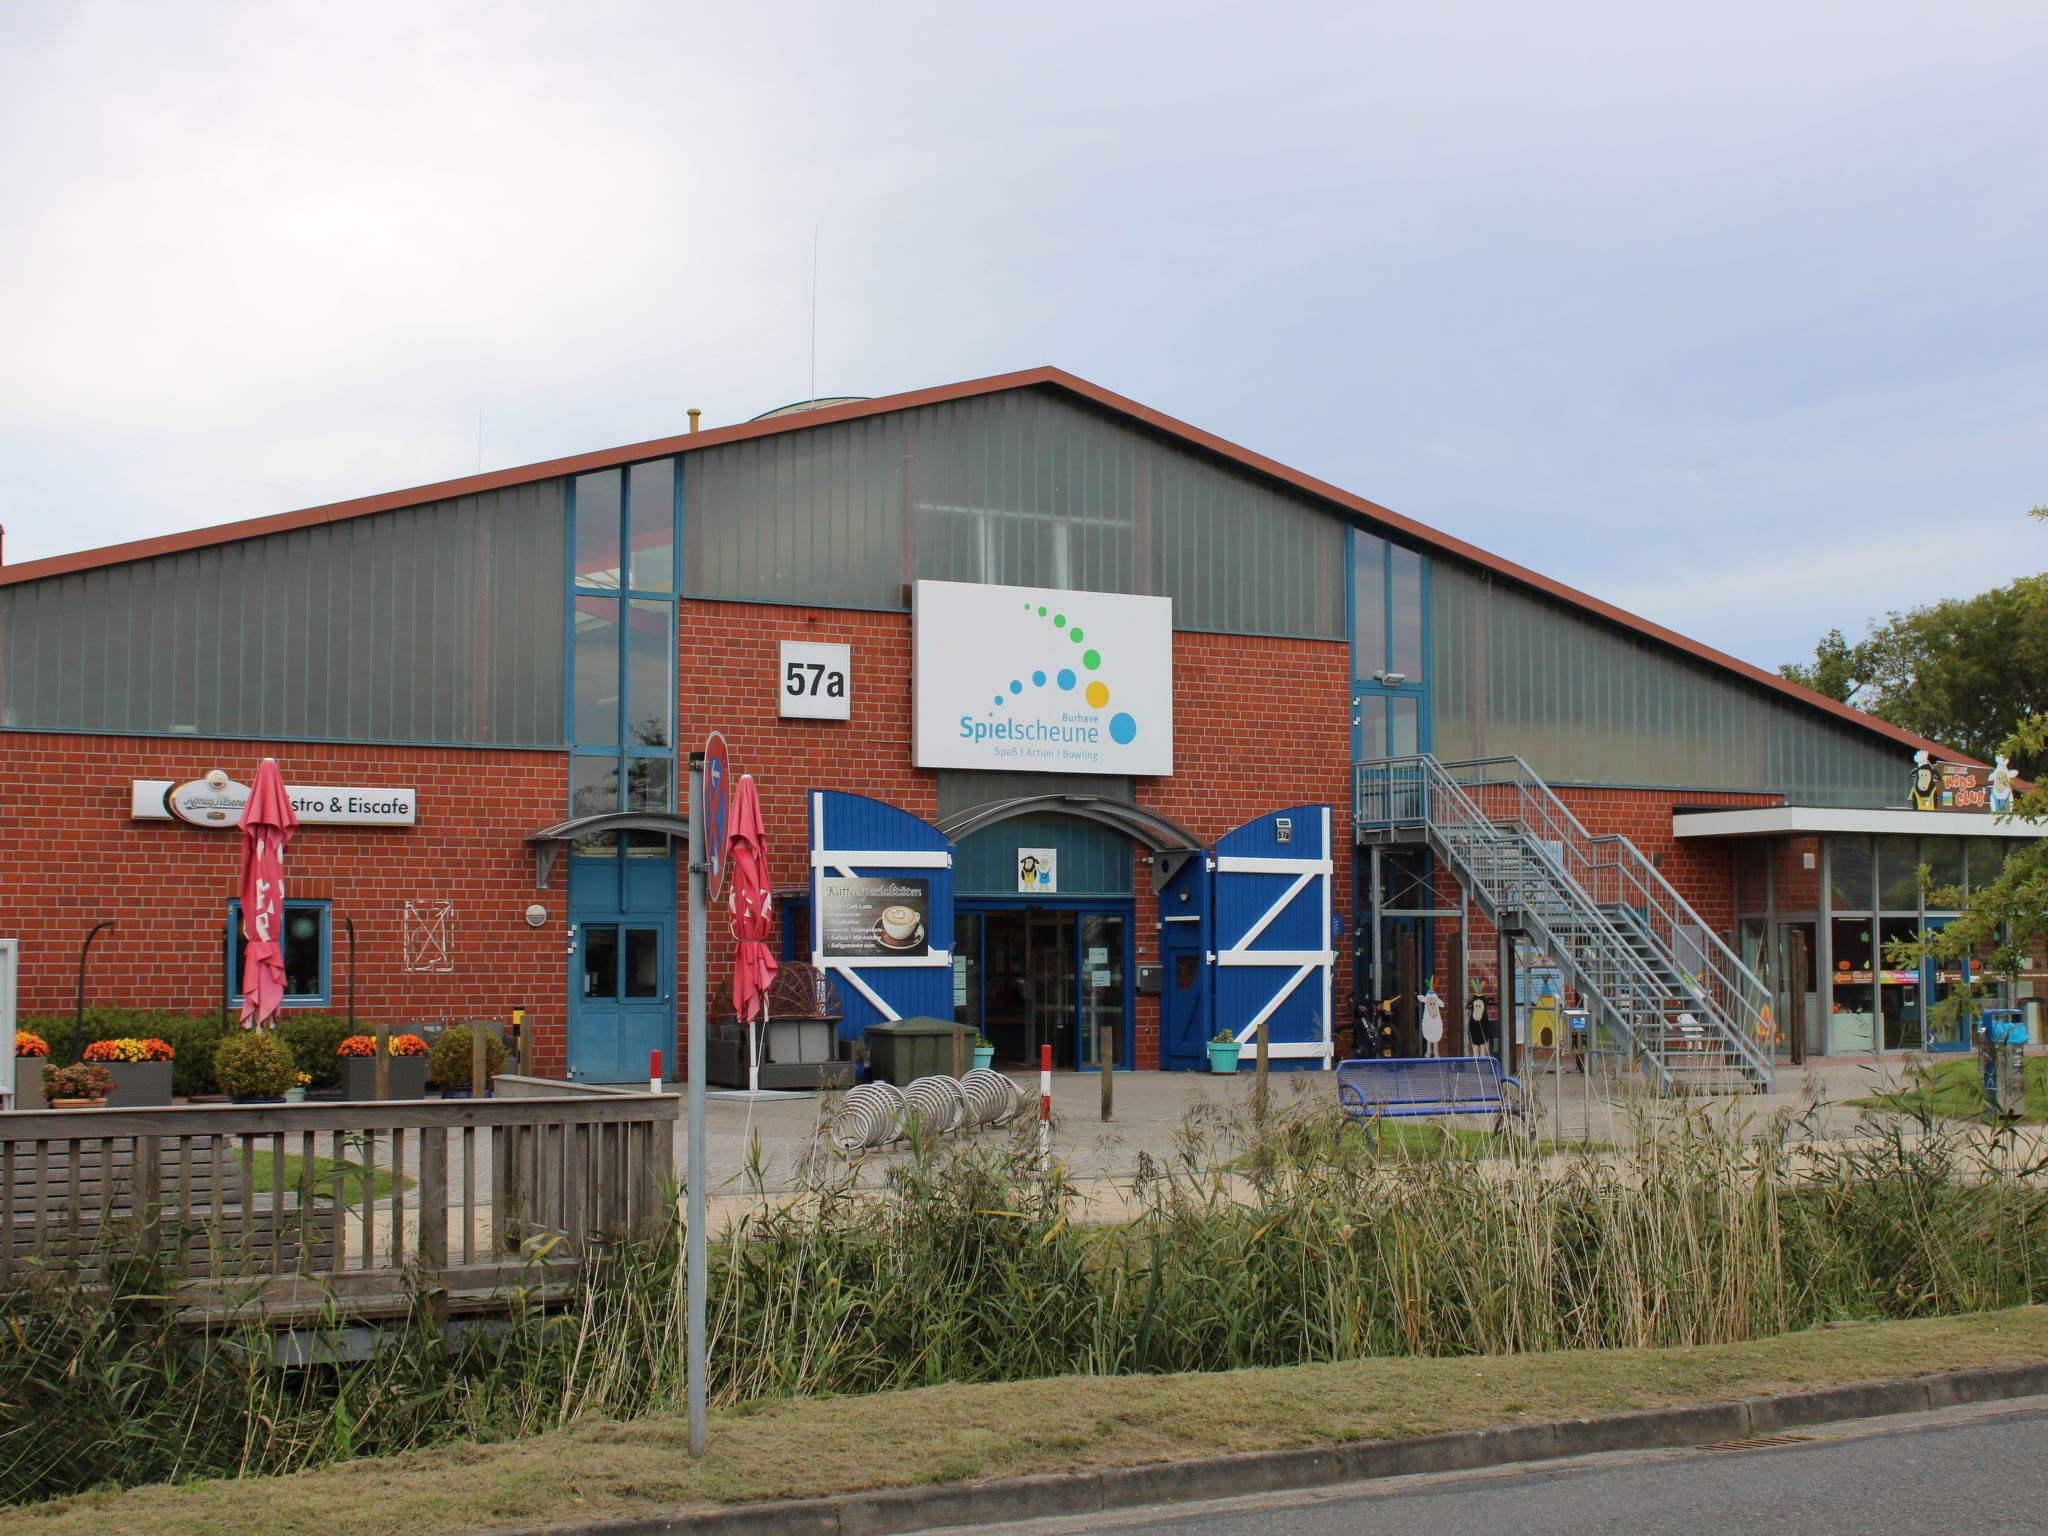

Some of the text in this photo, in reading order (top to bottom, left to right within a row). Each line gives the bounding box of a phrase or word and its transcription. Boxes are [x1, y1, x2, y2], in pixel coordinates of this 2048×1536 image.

[786, 662, 845, 698] 57a
[1062, 713, 1099, 724] Burhave
[959, 712, 1099, 744] Spielscheune
[994, 746, 1099, 762] Spaß Action Bowling
[329, 797, 342, 813] &
[348, 797, 409, 815] Eiscafe
[1278, 831, 1290, 839] 57a
